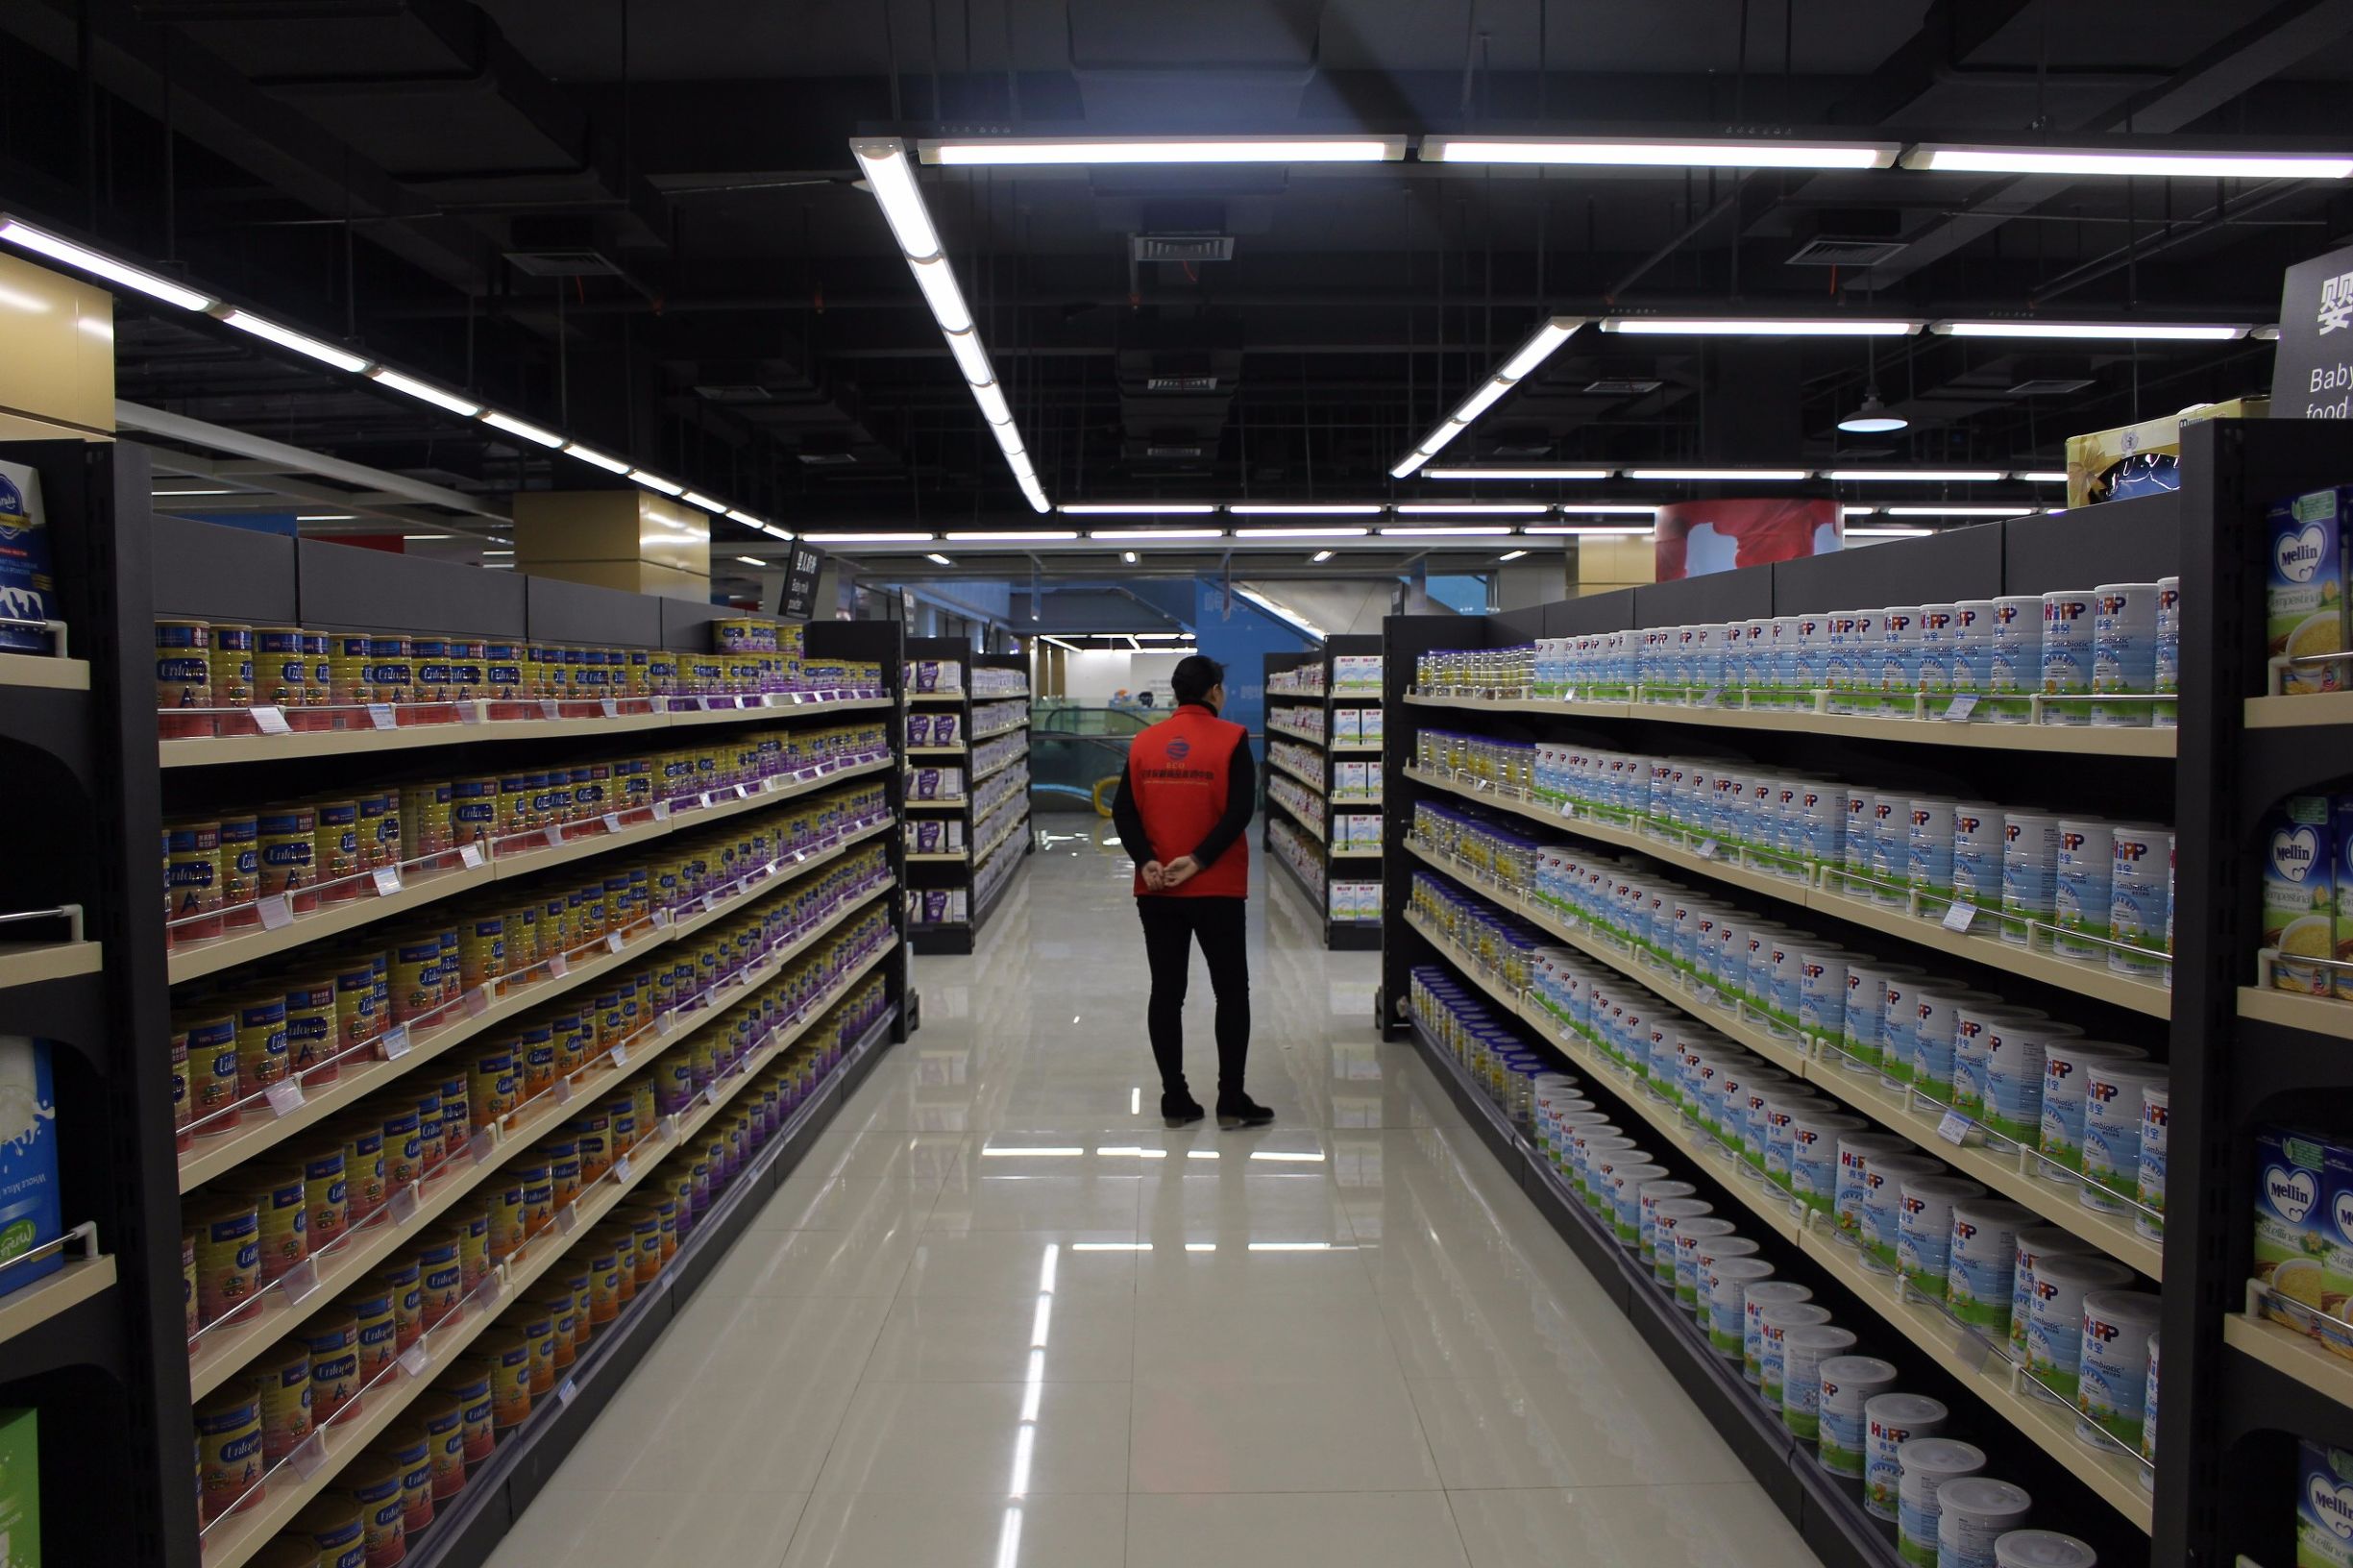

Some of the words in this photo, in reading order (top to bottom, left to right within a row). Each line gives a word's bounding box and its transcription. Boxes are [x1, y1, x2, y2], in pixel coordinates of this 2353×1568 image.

[2316, 271, 2353, 335] 婴
[2281, 545, 2317, 566] Mellin
[2045, 602, 2086, 621] HiPP
[2275, 845, 2311, 861] Mellin
[2269, 1183, 2309, 1204] Mellin
[1871, 1422, 1910, 1442] HiPP
